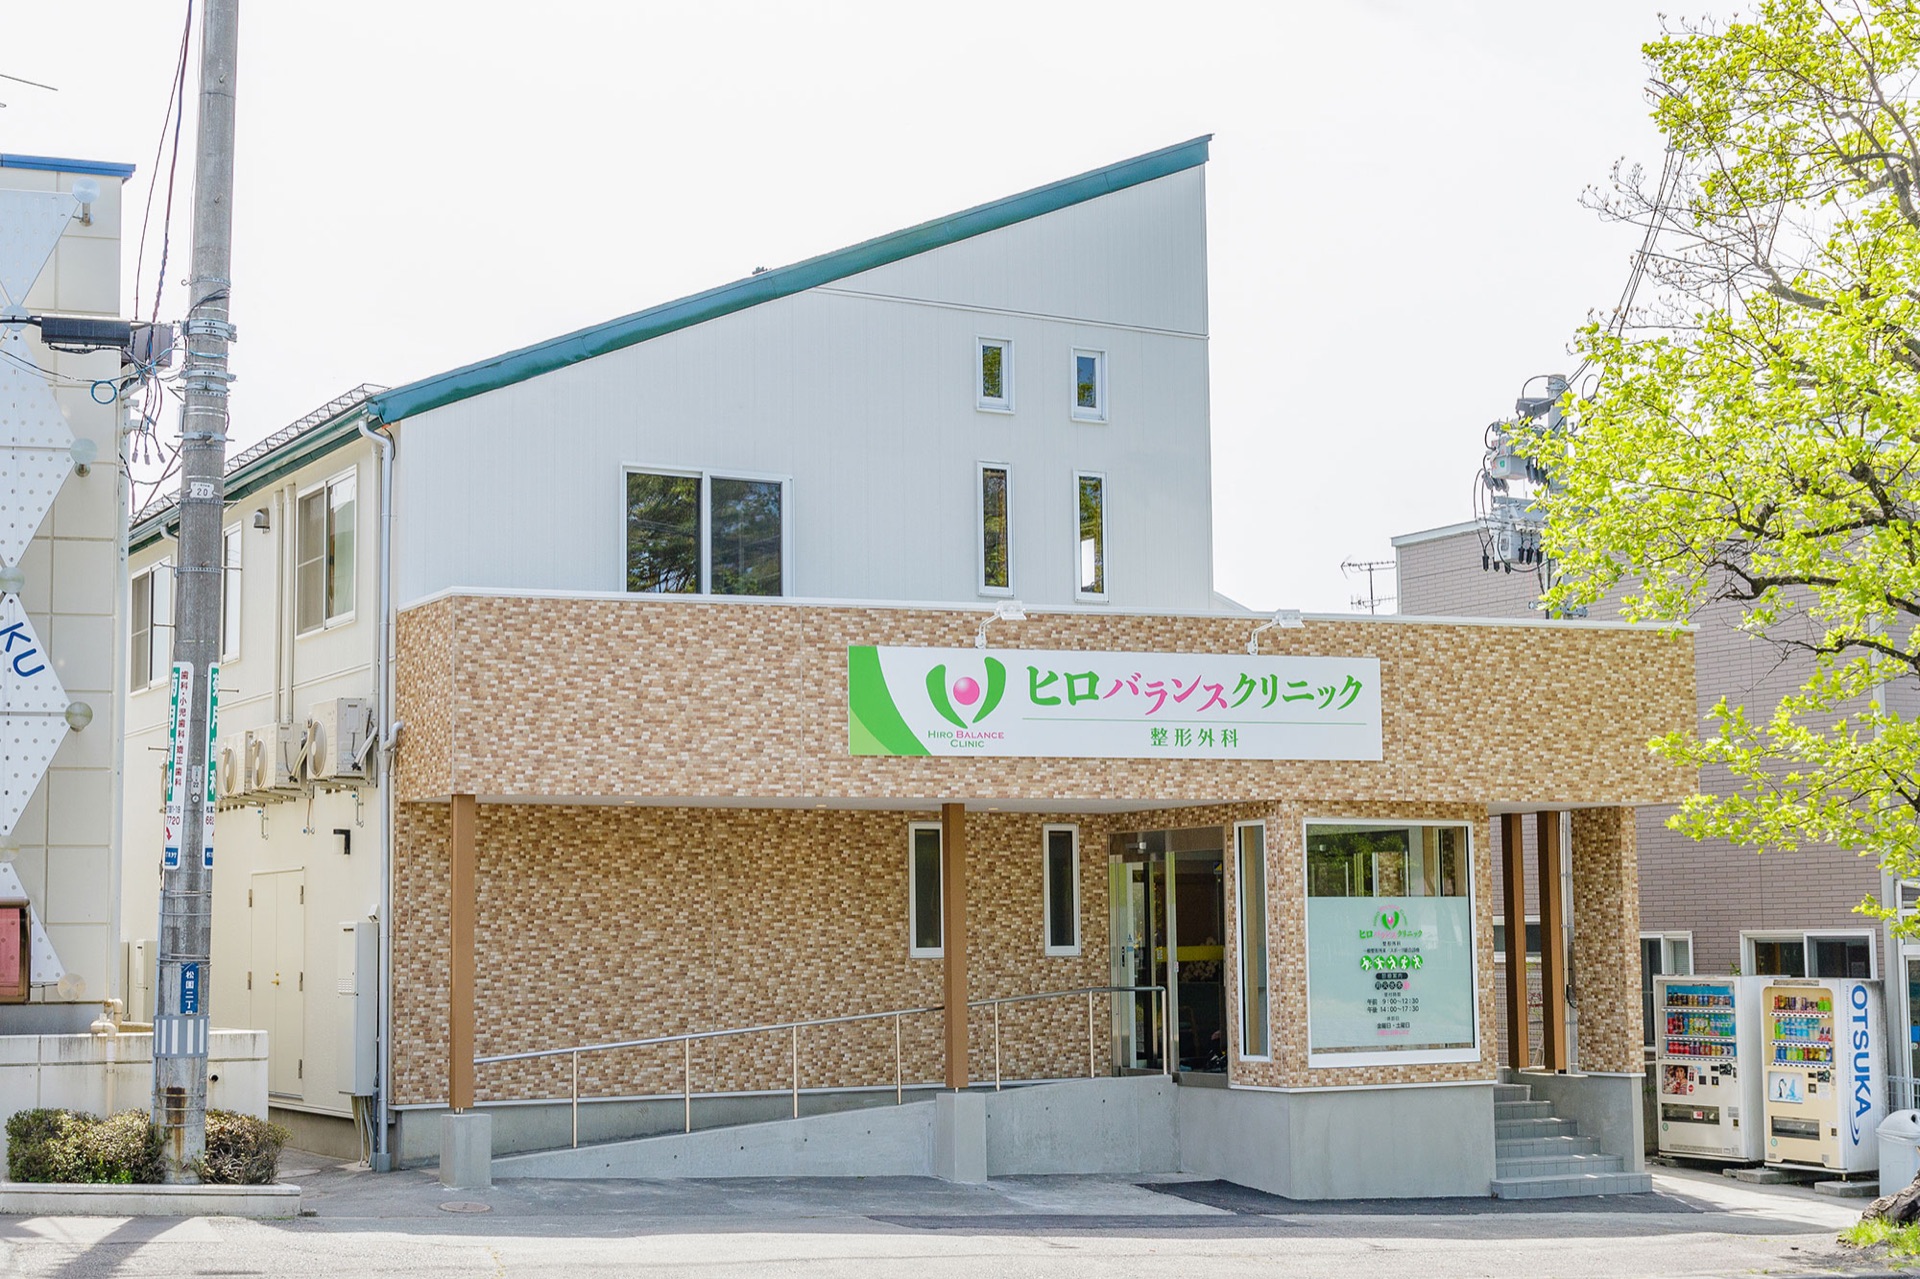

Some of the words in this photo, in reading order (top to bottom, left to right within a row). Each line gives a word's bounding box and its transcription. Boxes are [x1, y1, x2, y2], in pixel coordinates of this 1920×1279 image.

[196, 488, 208, 497] 20
[1026, 665, 1364, 716] ヒロバランスクリニック
[1150, 726, 1239, 748] 整形外科
[1851, 984, 1872, 1119] OTSUKA
